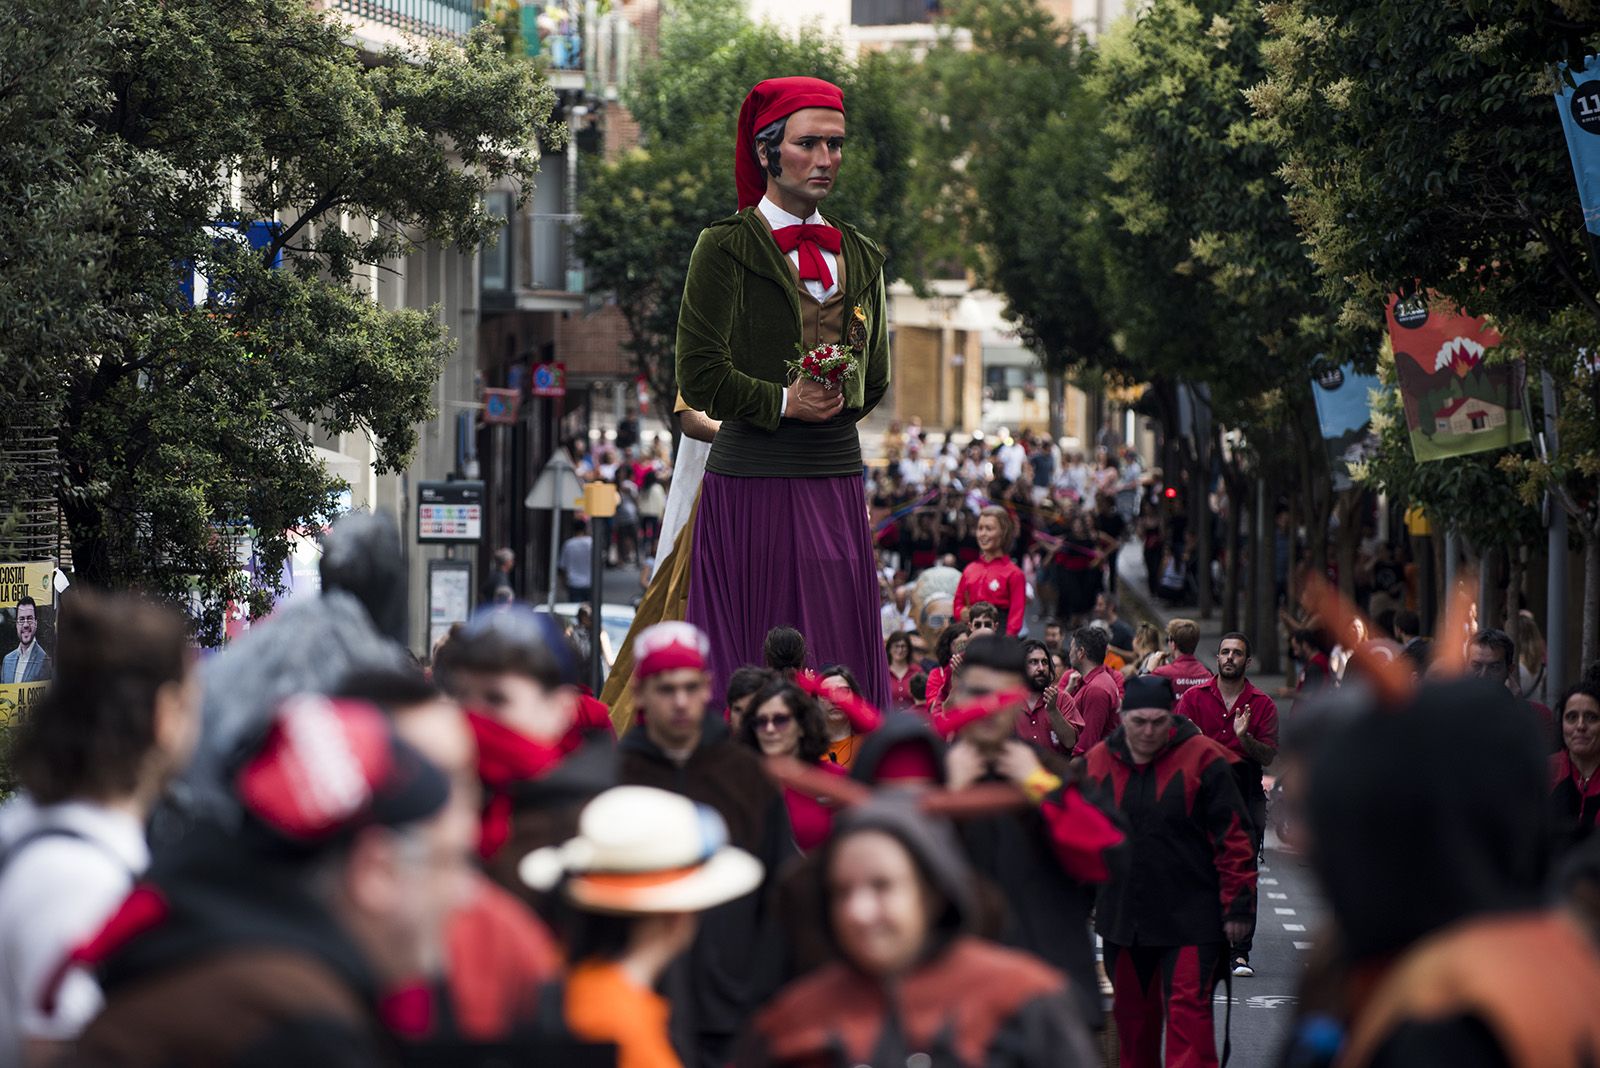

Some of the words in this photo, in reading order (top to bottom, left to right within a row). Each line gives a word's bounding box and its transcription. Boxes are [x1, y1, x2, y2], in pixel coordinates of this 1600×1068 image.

[0, 566, 25, 585] COSTAT
[1, 584, 10, 602] LA
[18, 687, 26, 706] AL
